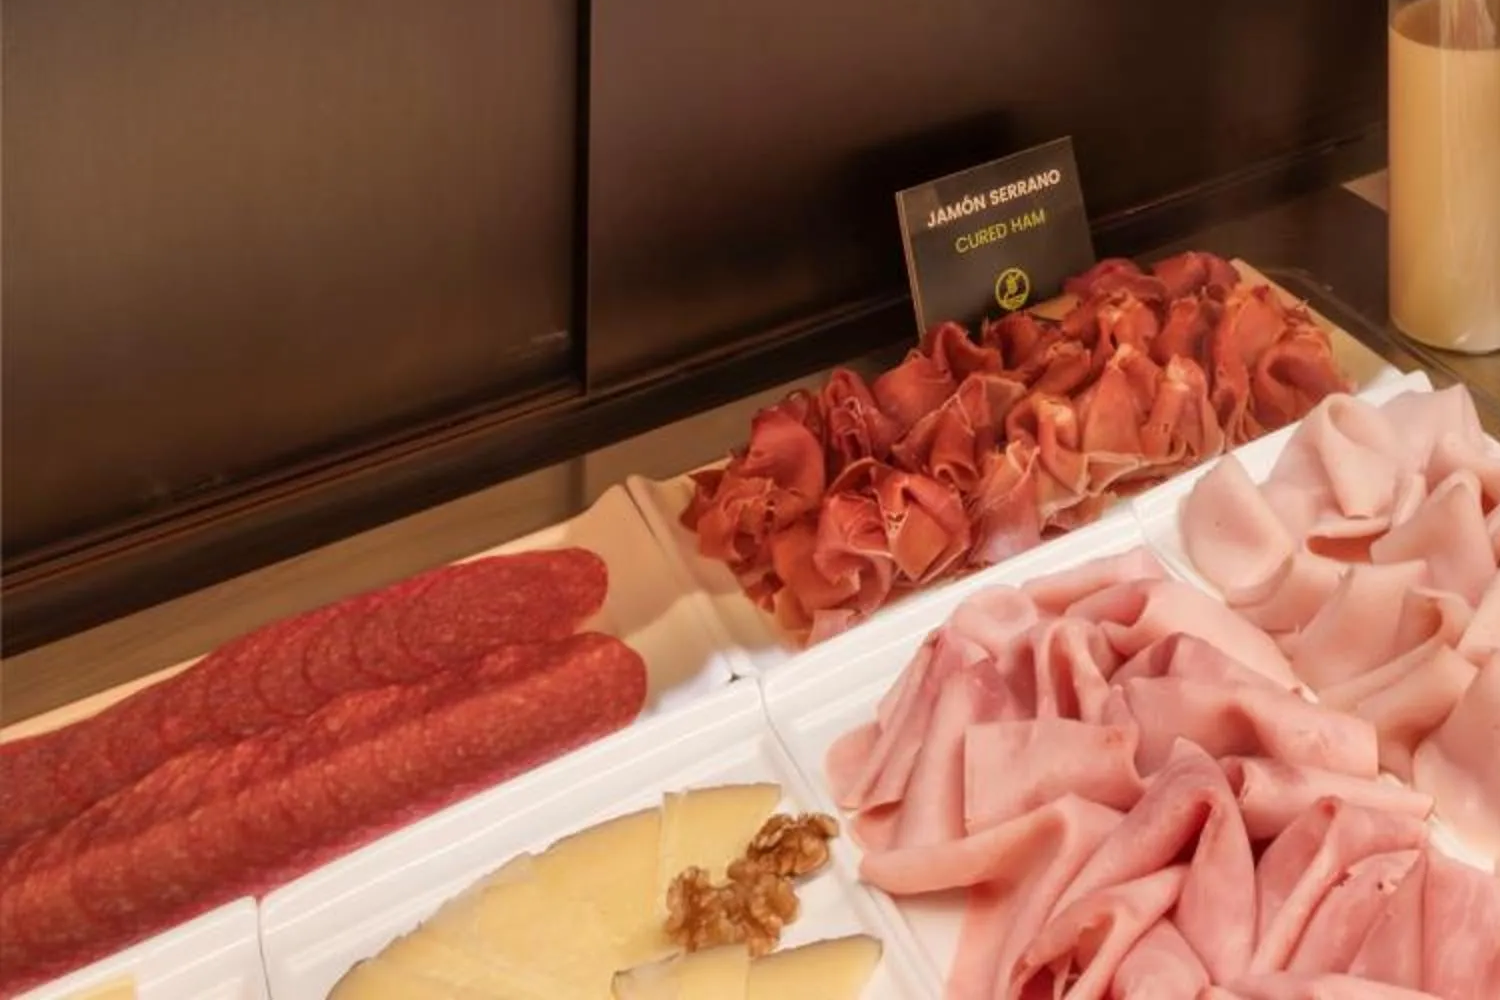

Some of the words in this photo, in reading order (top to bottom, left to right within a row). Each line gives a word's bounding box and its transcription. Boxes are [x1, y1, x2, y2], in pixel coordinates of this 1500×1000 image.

[927, 194, 987, 228] JAMÓN
[988, 168, 1062, 206] SERRANO
[954, 222, 1009, 254] CURED
[1010, 208, 1047, 233] HAM
